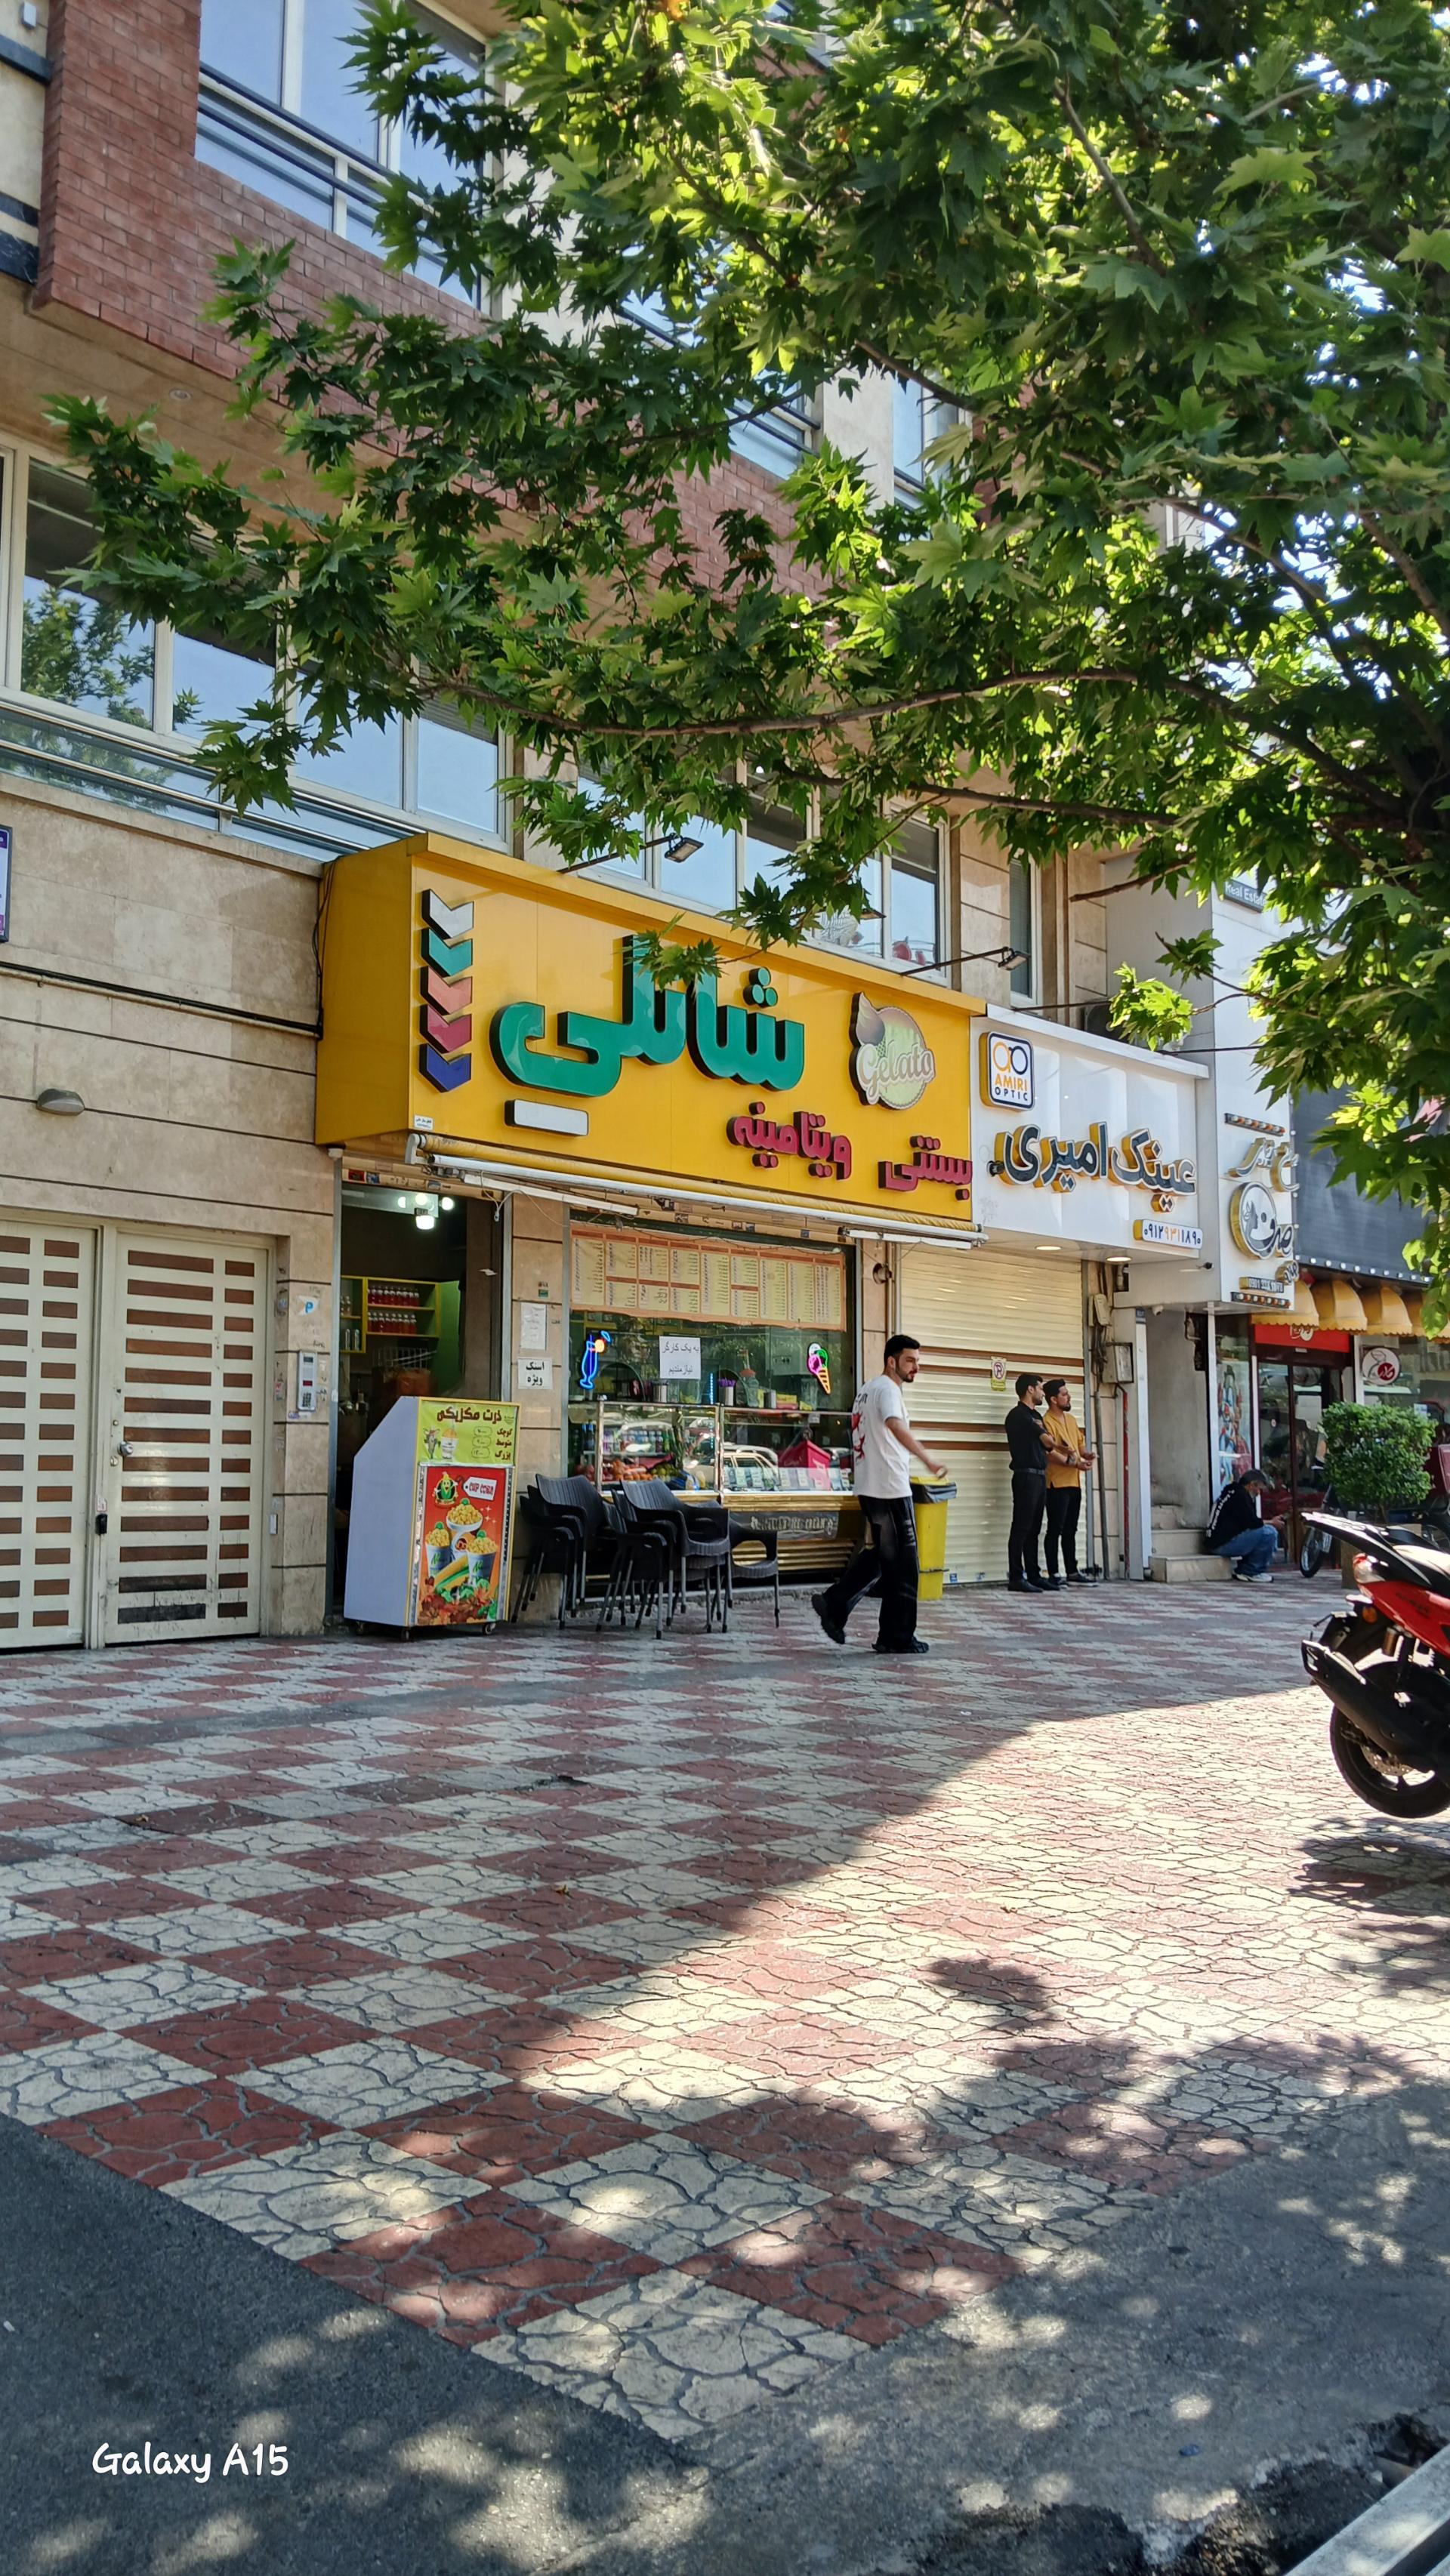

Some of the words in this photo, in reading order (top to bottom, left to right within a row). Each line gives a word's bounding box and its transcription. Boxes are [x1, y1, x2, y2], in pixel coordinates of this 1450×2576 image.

[858, 1039, 933, 1098] Gelato
[995, 1073, 1028, 1092] AMIRI
[995, 1086, 1028, 1102] OPTIC
[727, 1101, 852, 1180] ویتامینه
[995, 1121, 1108, 1193] امیری
[878, 1135, 973, 1201] بستنی
[1108, 1128, 1196, 1213] عینک
[662, 1340, 679, 1354] کارگر
[527, 1374, 543, 1386] ویژه
[483, 1409, 502, 1424] ذرت
[469, 1482, 480, 1493] CUP
